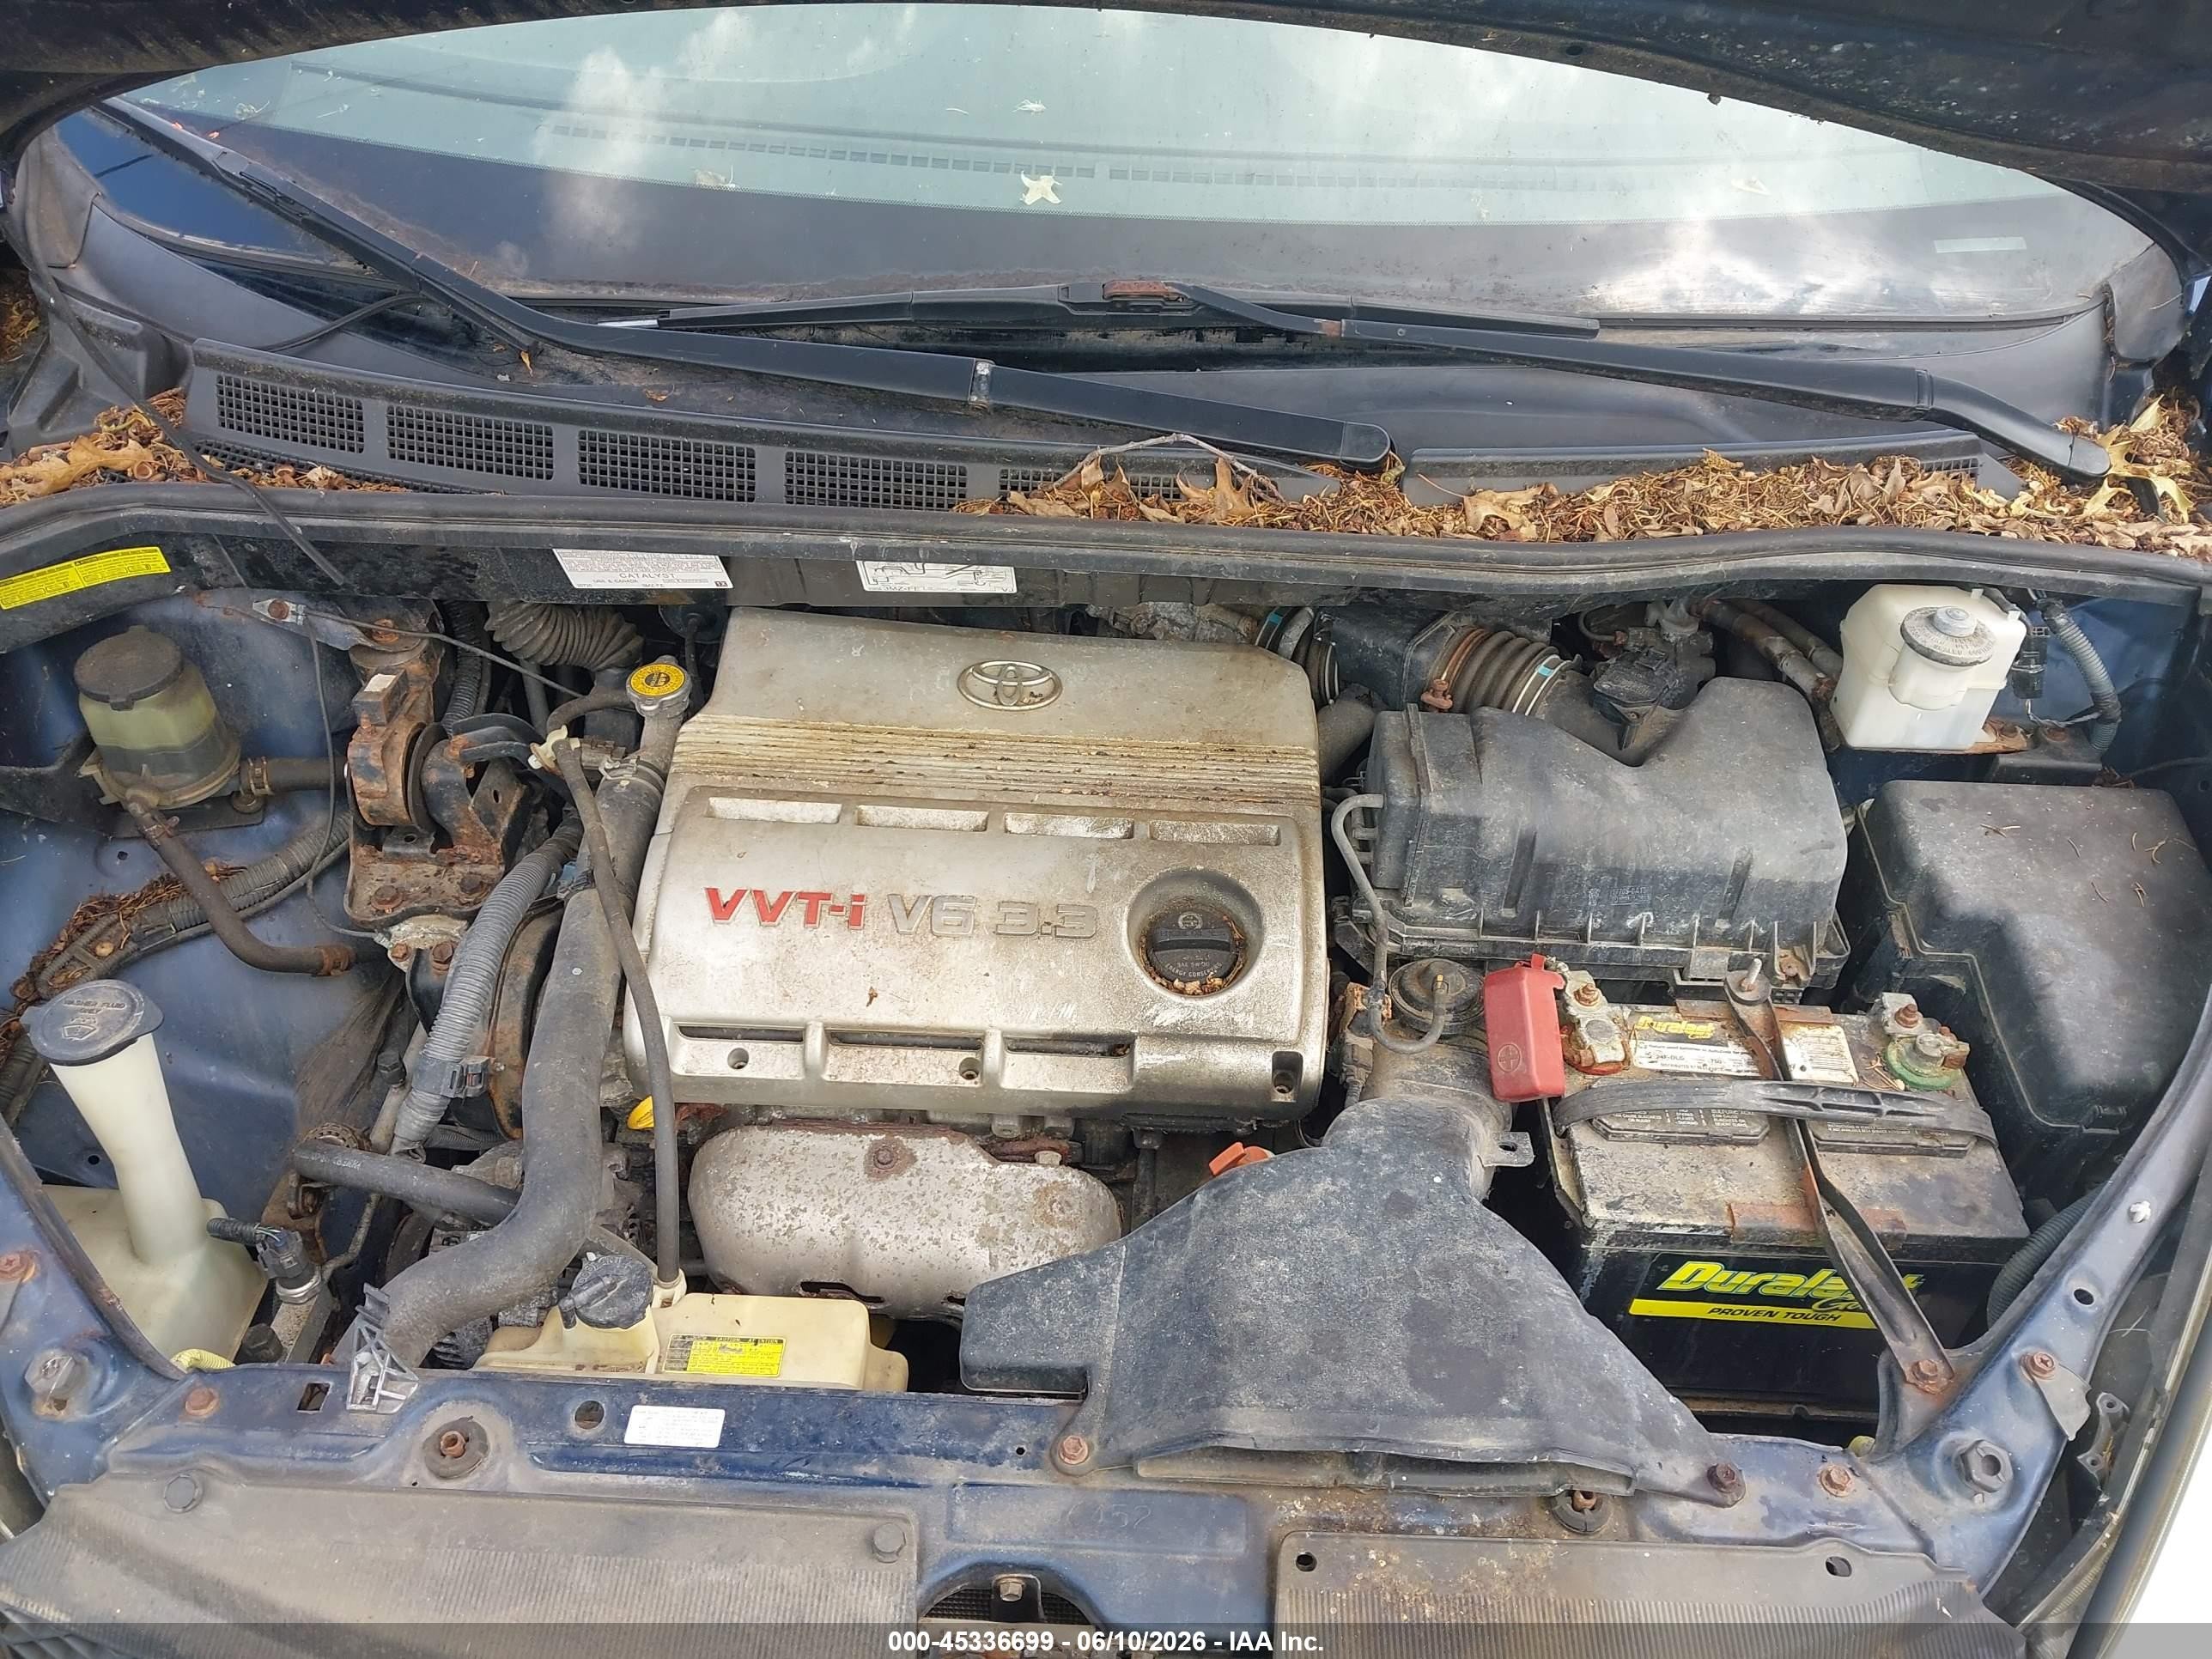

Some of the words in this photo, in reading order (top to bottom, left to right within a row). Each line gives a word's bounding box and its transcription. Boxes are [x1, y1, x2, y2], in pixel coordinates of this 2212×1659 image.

[704, 886, 866, 930] VVT-i
[887, 893, 977, 937] V6
[994, 900, 1099, 939] 3.3
[100, 1000, 126, 1010] FLUID
[1708, 1307, 1780, 1318] PROVEN
[1783, 1310, 1841, 1322] TOUGH
